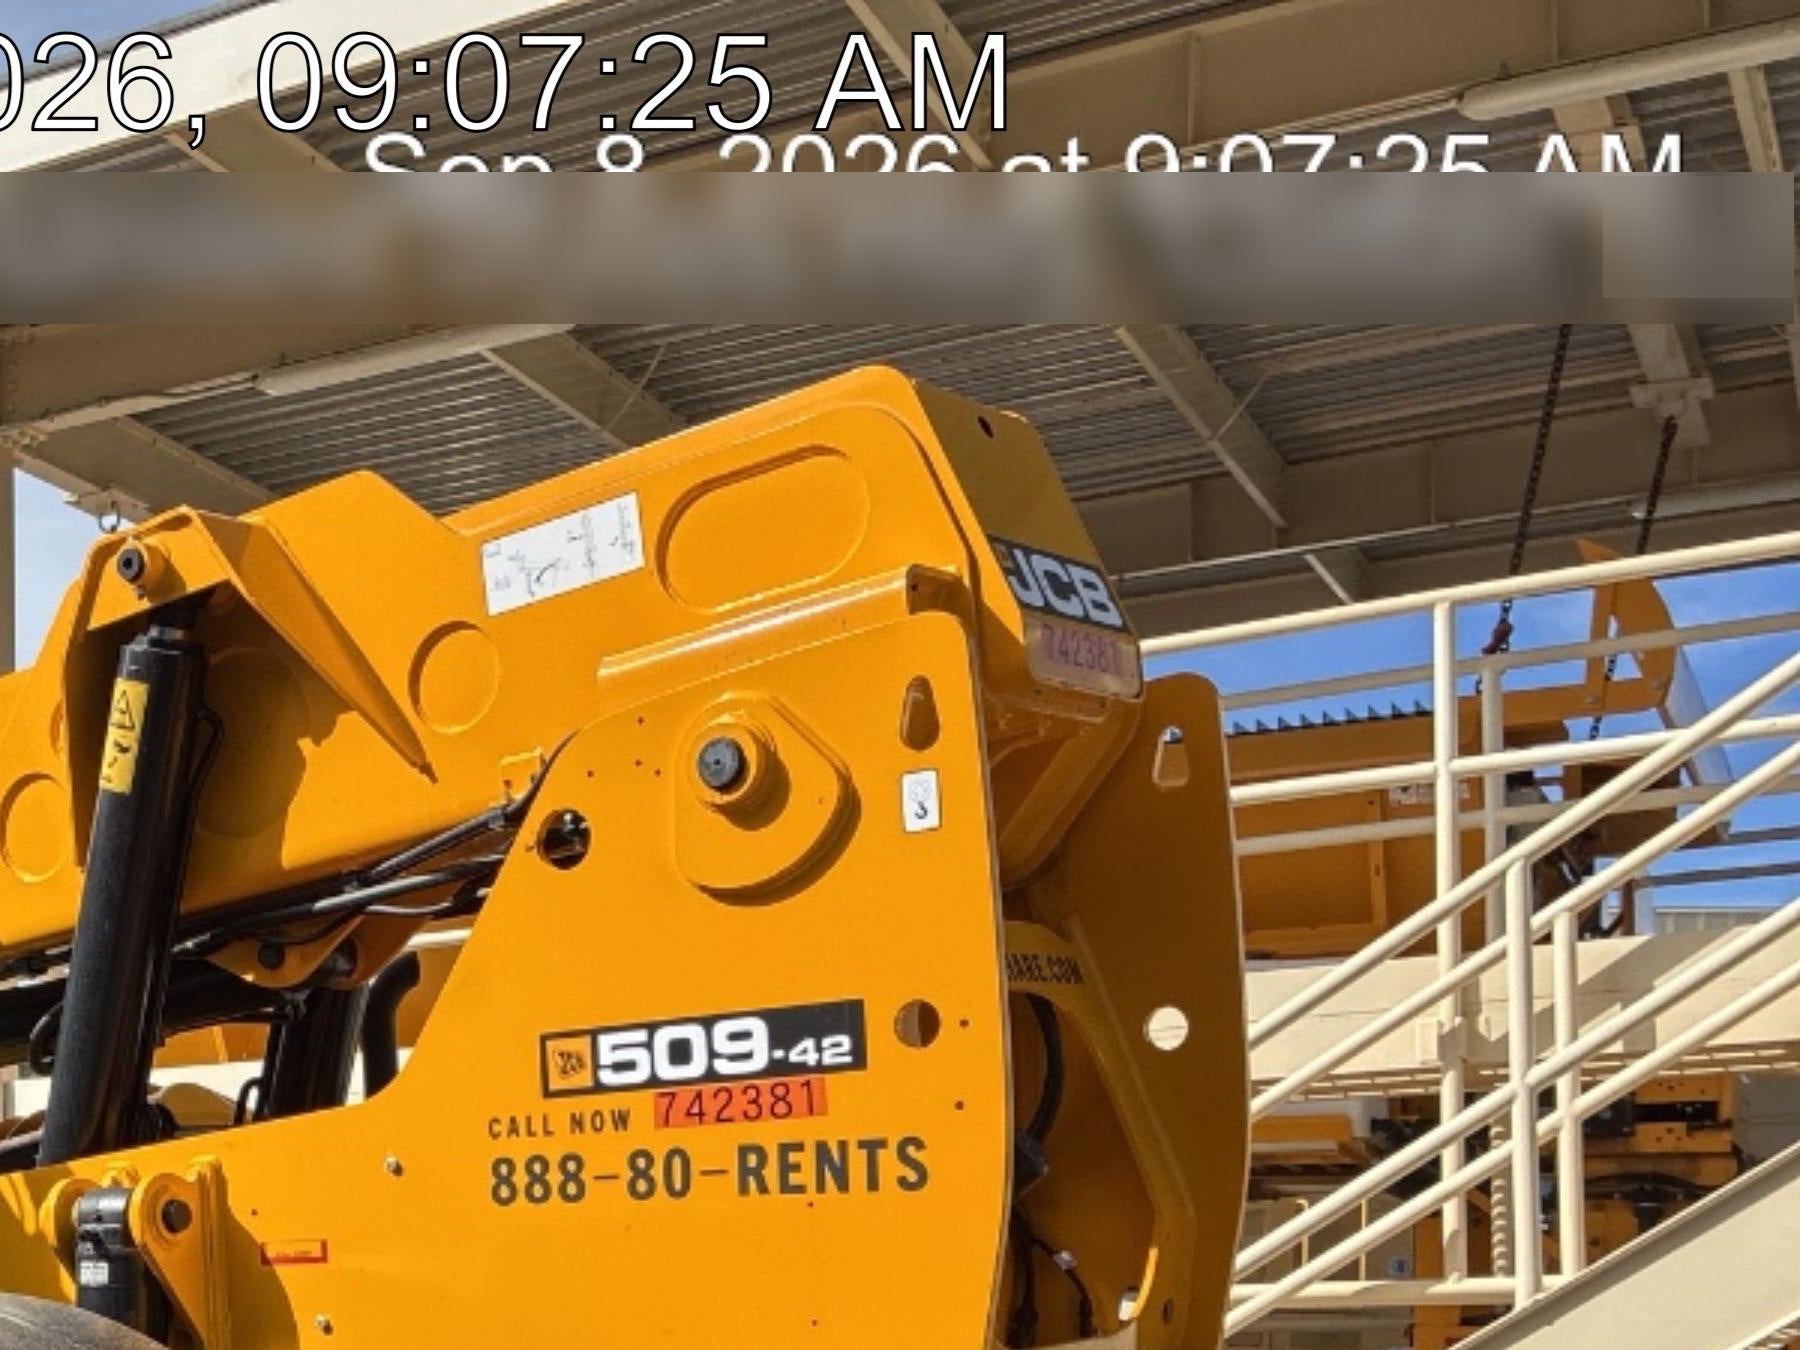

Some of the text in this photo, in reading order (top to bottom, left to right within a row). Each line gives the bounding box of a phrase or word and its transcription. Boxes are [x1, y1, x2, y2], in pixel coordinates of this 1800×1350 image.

[1006, 548, 1125, 628] JCB
[488, 1108, 632, 1140] CALL NOW
[658, 1079, 816, 1128] 742381
[490, 1136, 930, 1207] 888-80-RENTS
